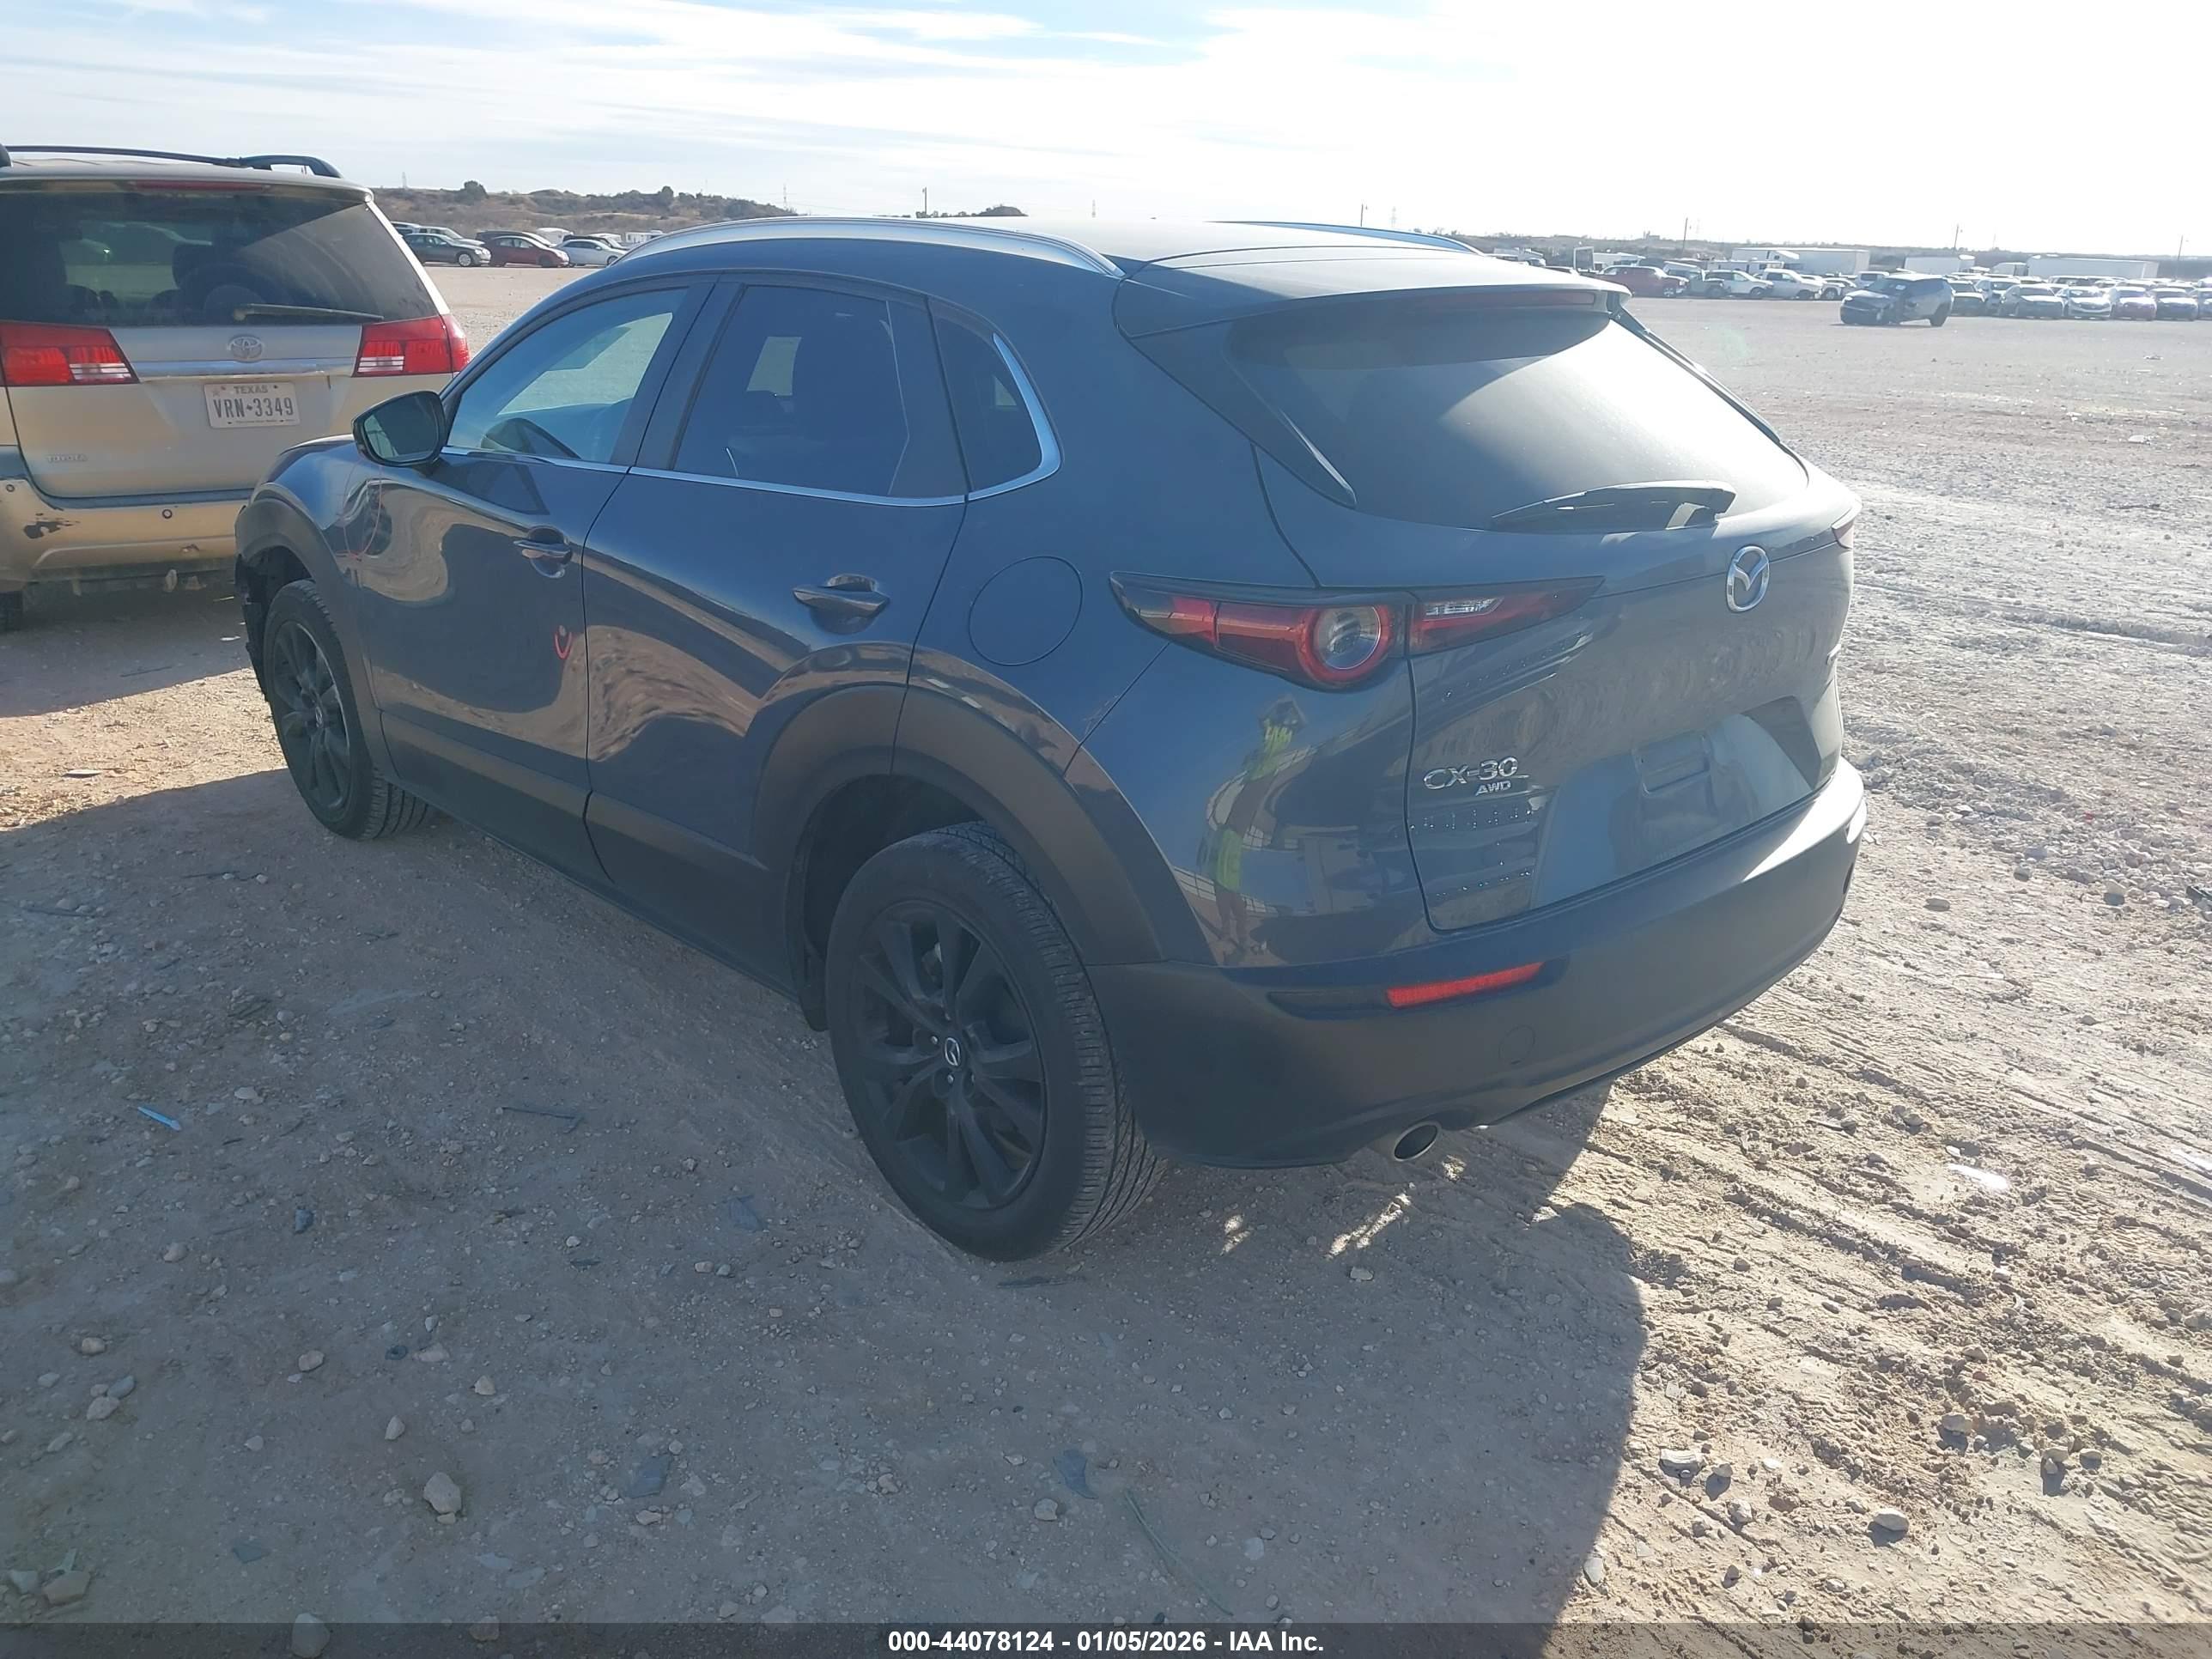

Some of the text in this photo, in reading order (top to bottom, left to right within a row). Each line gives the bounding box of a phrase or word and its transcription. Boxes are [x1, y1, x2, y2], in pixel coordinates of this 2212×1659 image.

[234, 385, 268, 394] TEXAS
[1424, 757, 1518, 790] CX-30
[1475, 781, 1511, 796] AWD
